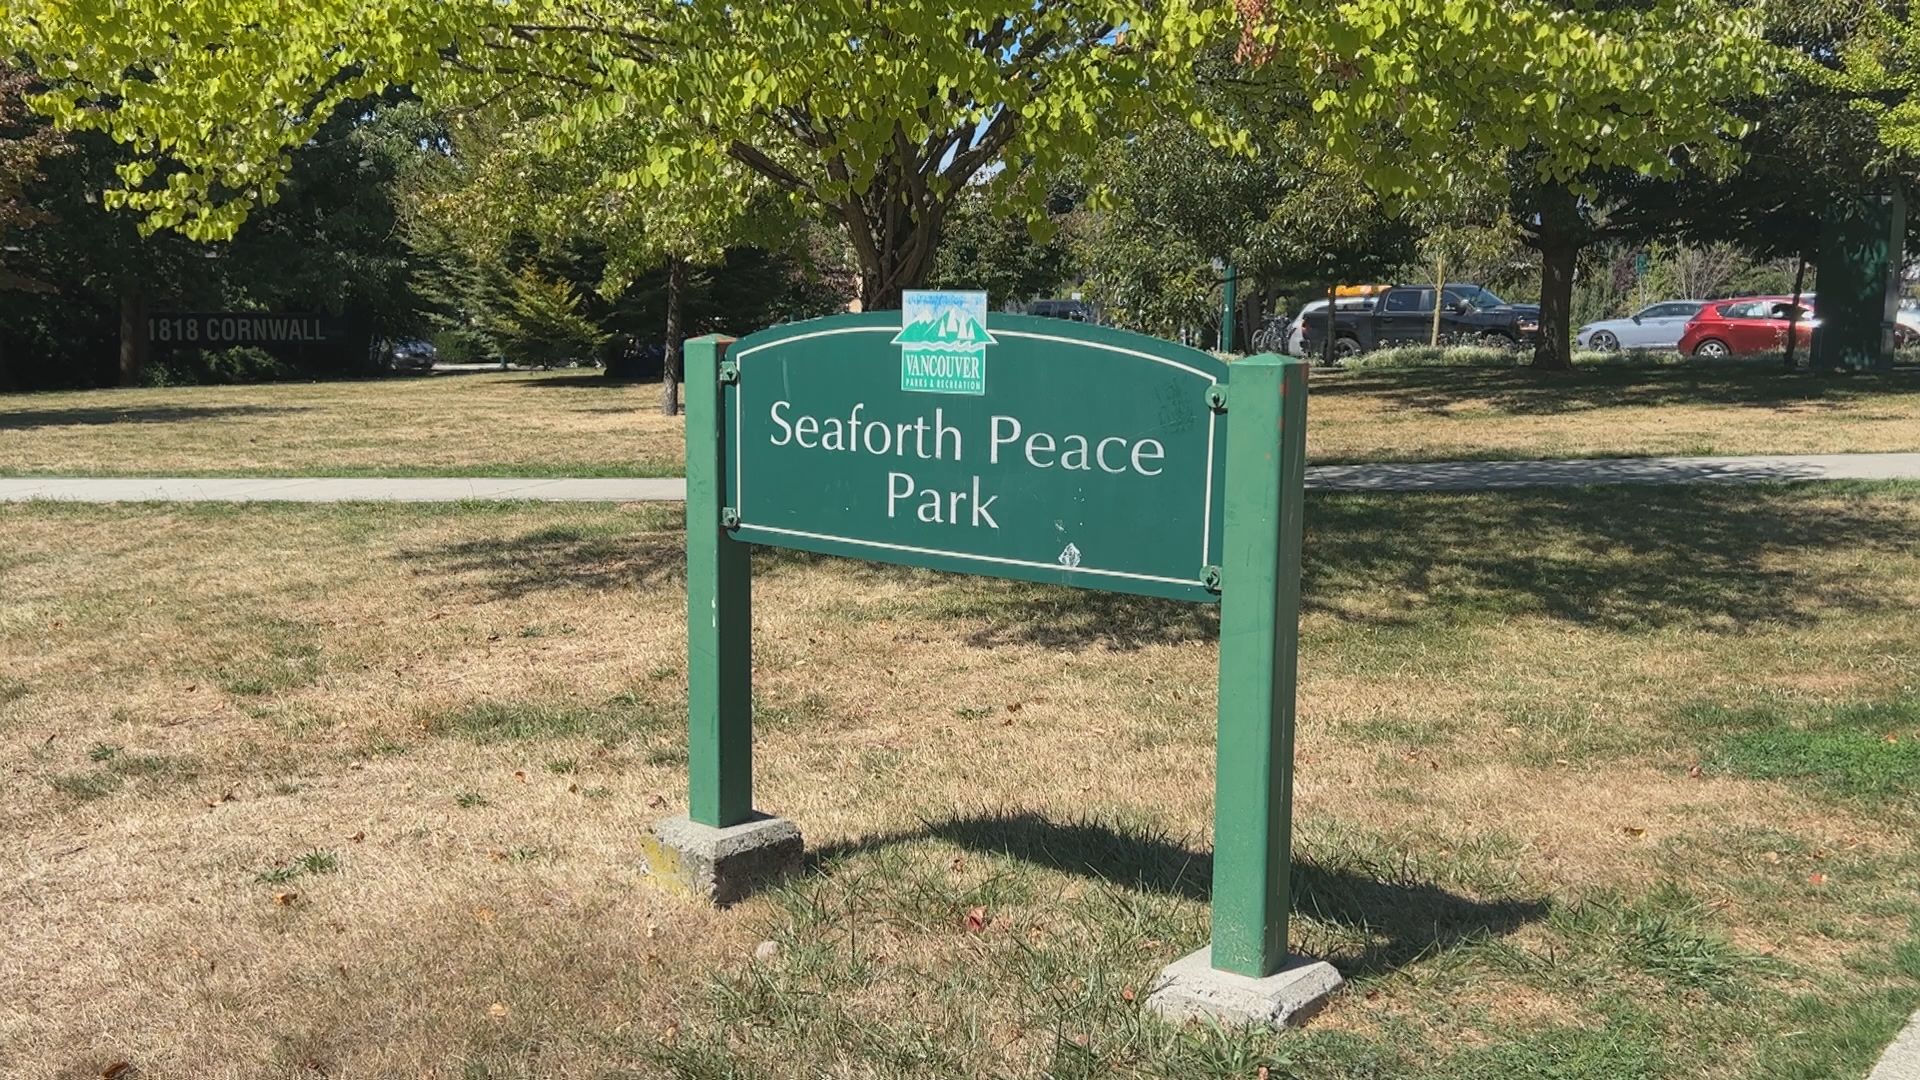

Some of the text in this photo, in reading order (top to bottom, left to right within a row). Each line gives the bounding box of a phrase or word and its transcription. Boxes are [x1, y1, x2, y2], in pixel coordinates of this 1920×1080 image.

[147, 318, 326, 341] 1818 CORNWALL
[905, 355, 980, 379] VANCOUVER
[905, 378, 981, 390] PARKS & RECREATION
[770, 400, 1165, 476] Seaforth Peace
[887, 472, 999, 530] Park
